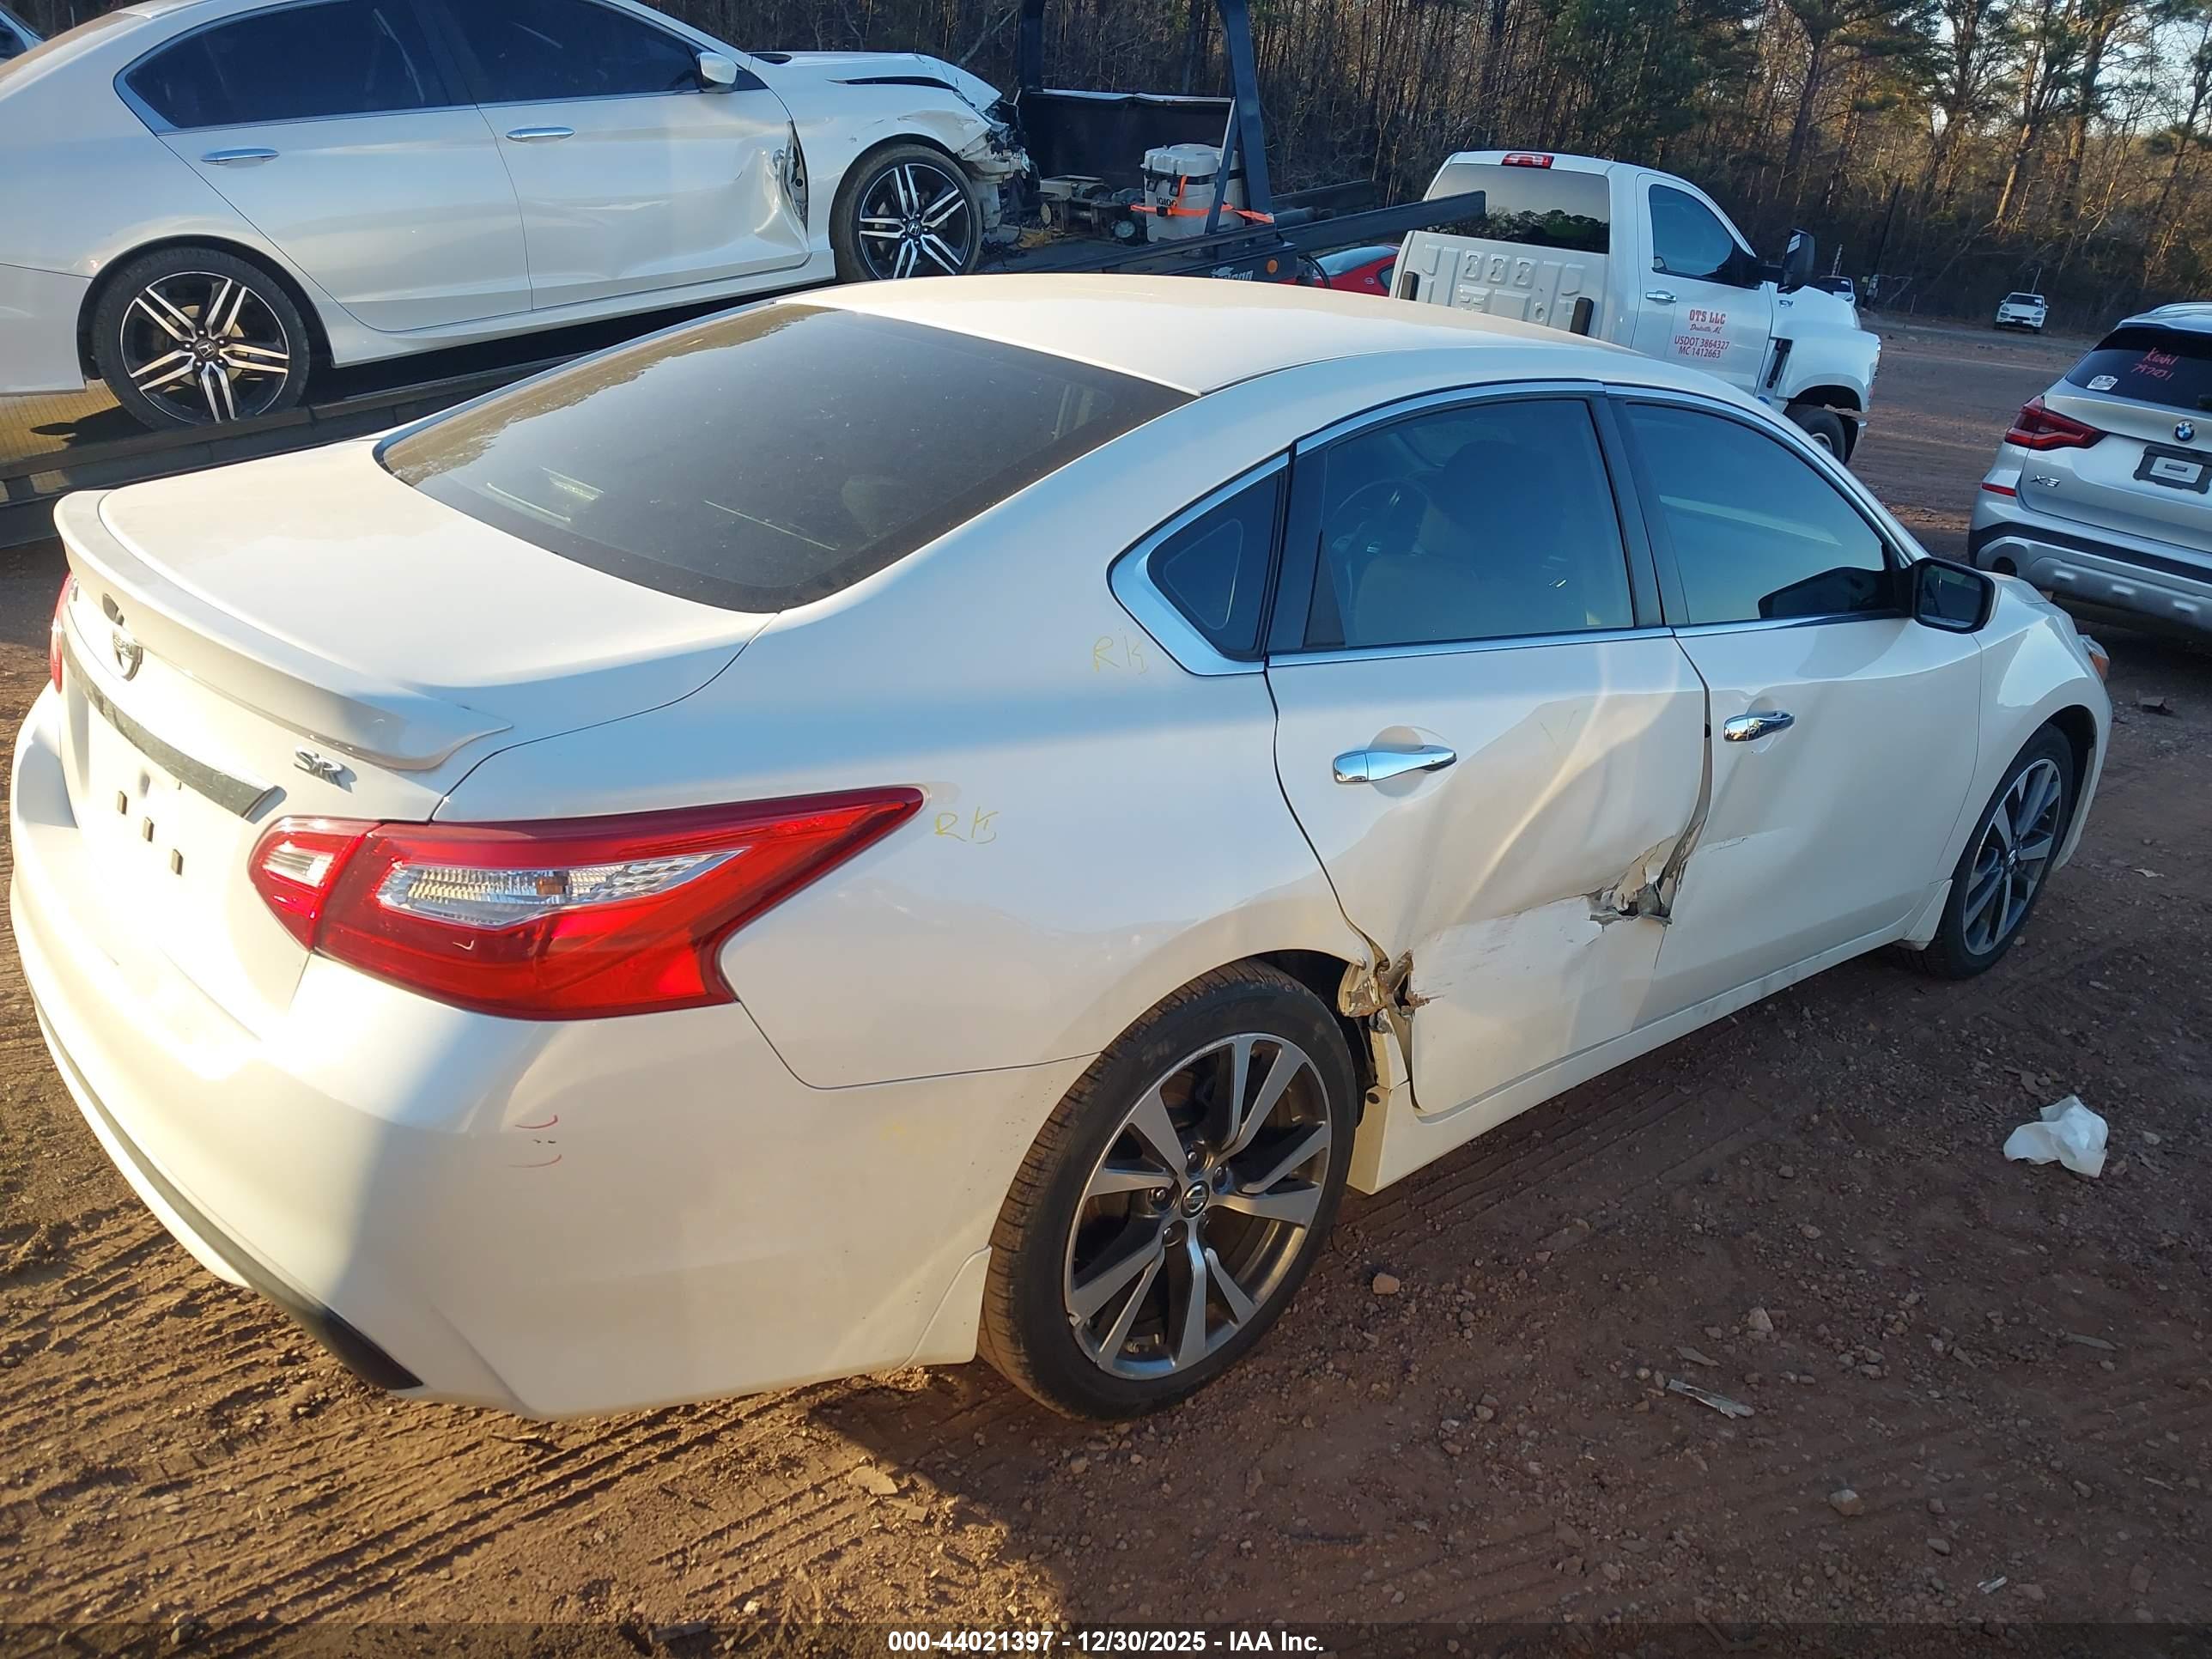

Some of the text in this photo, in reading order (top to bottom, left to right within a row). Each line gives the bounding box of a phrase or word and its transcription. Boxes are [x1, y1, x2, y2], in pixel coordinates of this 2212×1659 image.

[1689, 309, 1726, 325] OTS LLC
[1674, 335, 1730, 349] USDOT 3864327
[1678, 346, 1721, 358] MC 1412663
[2029, 474, 2060, 487] X3
[293, 746, 346, 781] SR
